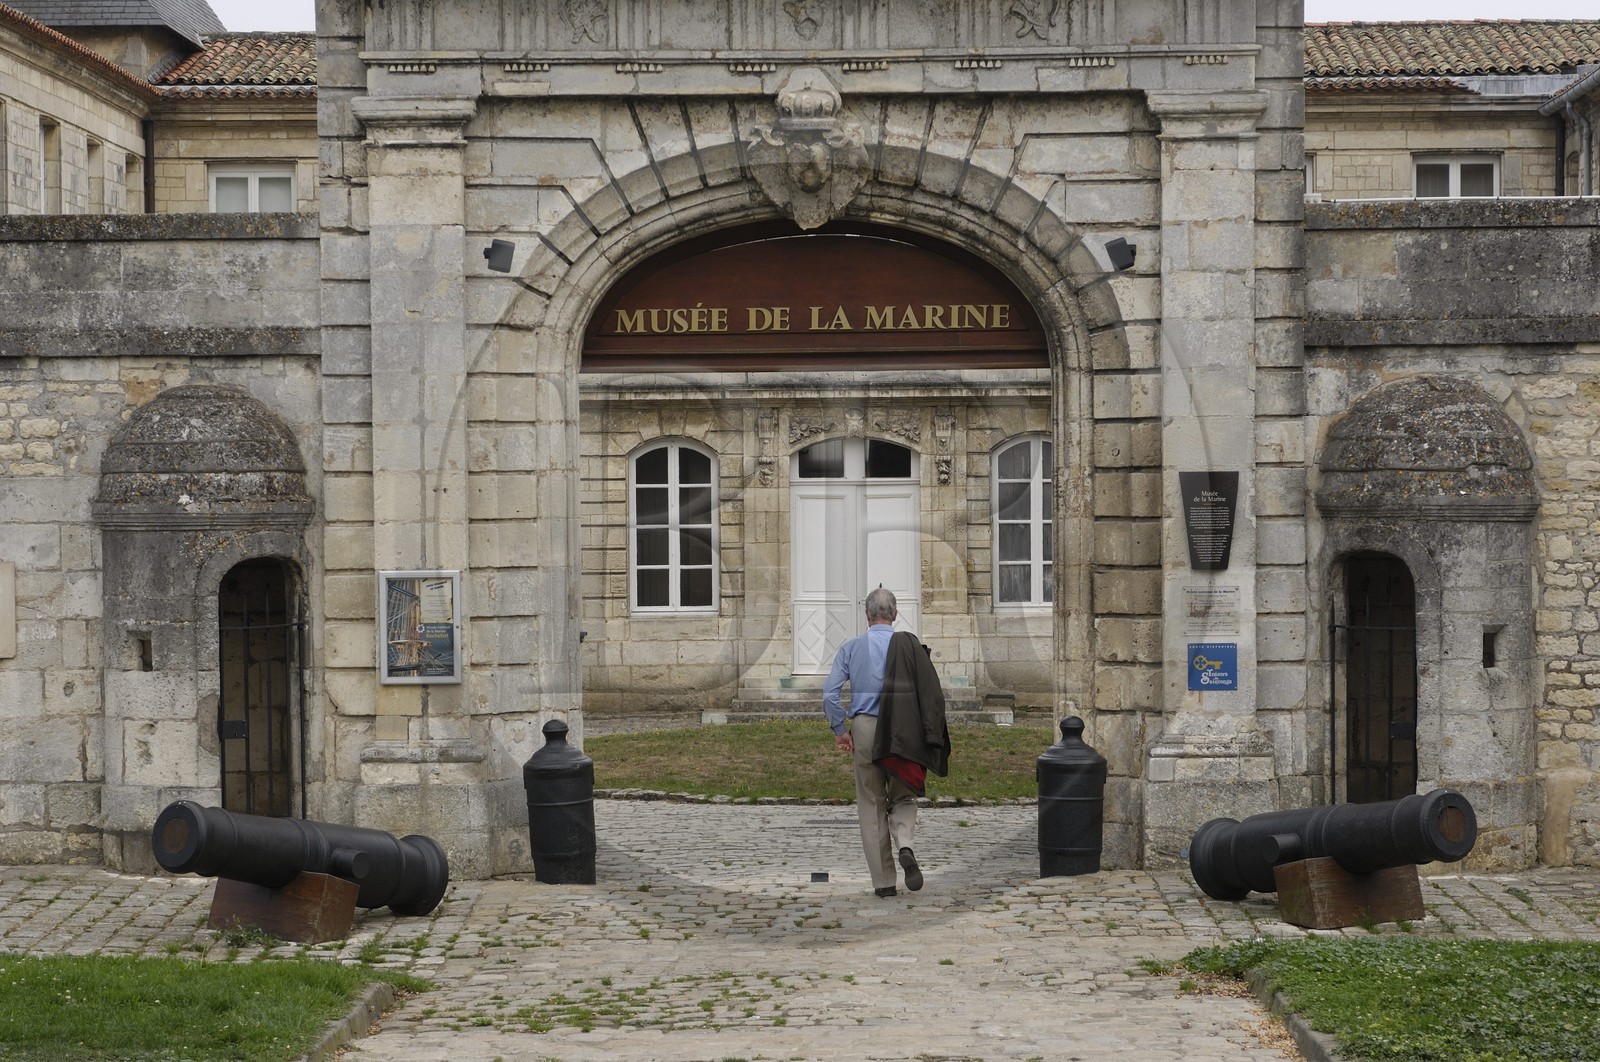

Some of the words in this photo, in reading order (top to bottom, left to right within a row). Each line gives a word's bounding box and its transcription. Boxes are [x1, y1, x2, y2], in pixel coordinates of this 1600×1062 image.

[614, 302, 729, 334] MUSÉE
[746, 307, 791, 332] DE
[808, 305, 853, 330] LA
[863, 304, 1010, 330] MARINE
